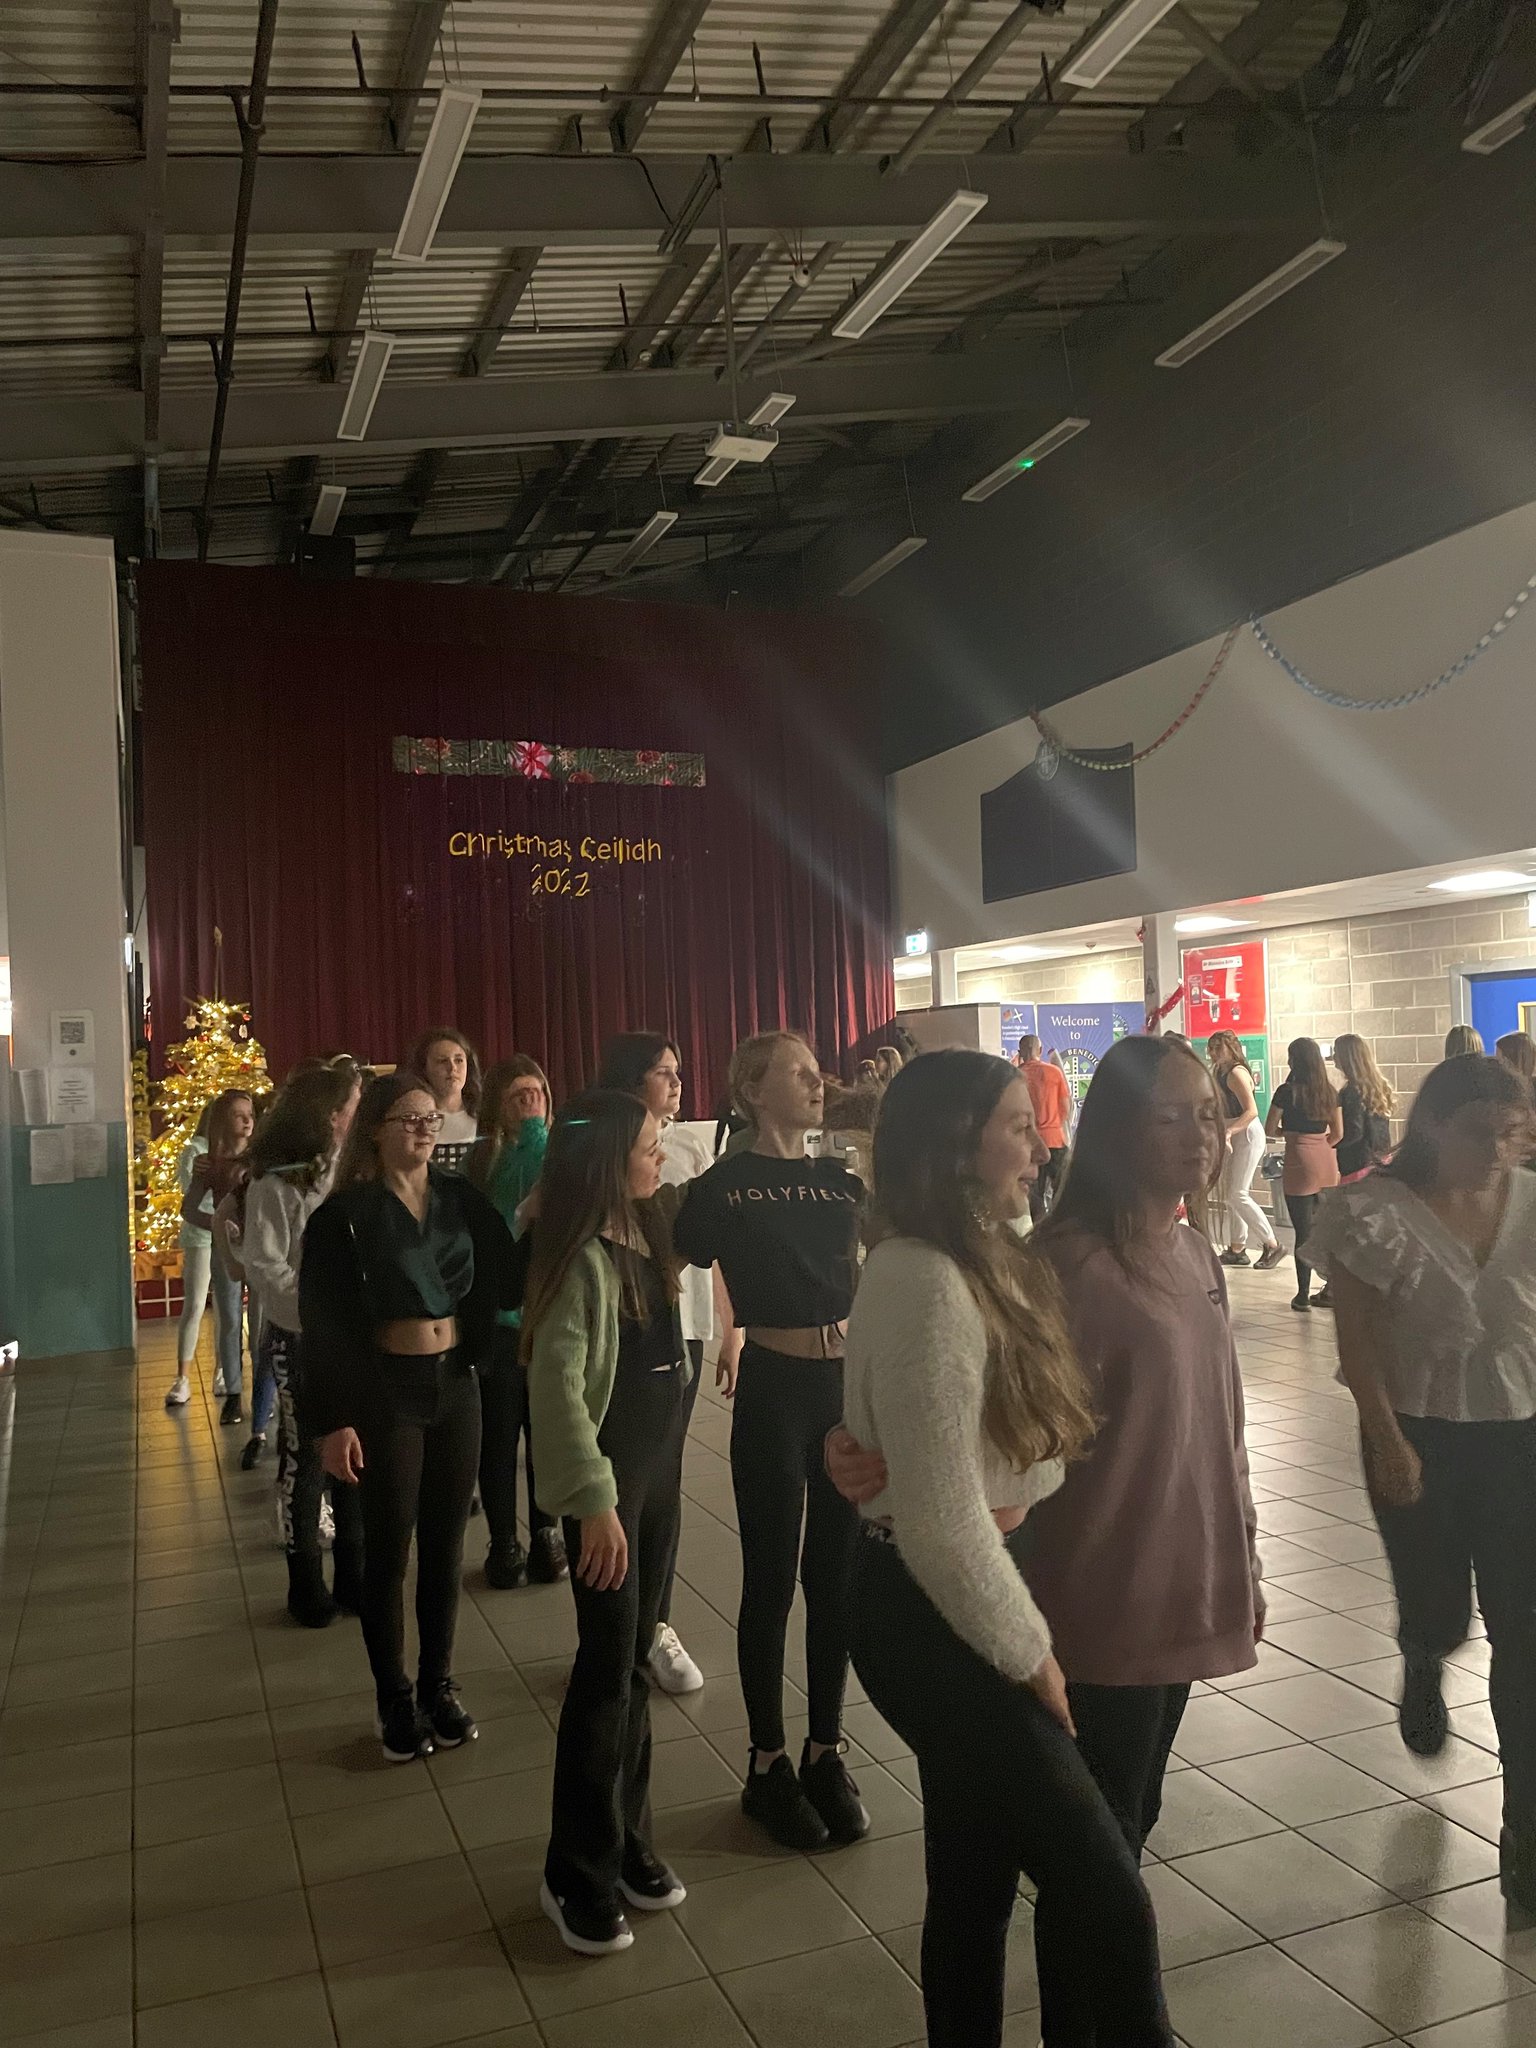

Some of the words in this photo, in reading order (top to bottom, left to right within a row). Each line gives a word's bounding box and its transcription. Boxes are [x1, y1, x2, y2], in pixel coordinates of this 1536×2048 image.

[449, 829, 572, 862] Christmas
[580, 836, 662, 864] Ceilidh
[530, 863, 591, 897] 2022
[1050, 1015, 1100, 1026] Welcome
[1070, 1030, 1081, 1040] to
